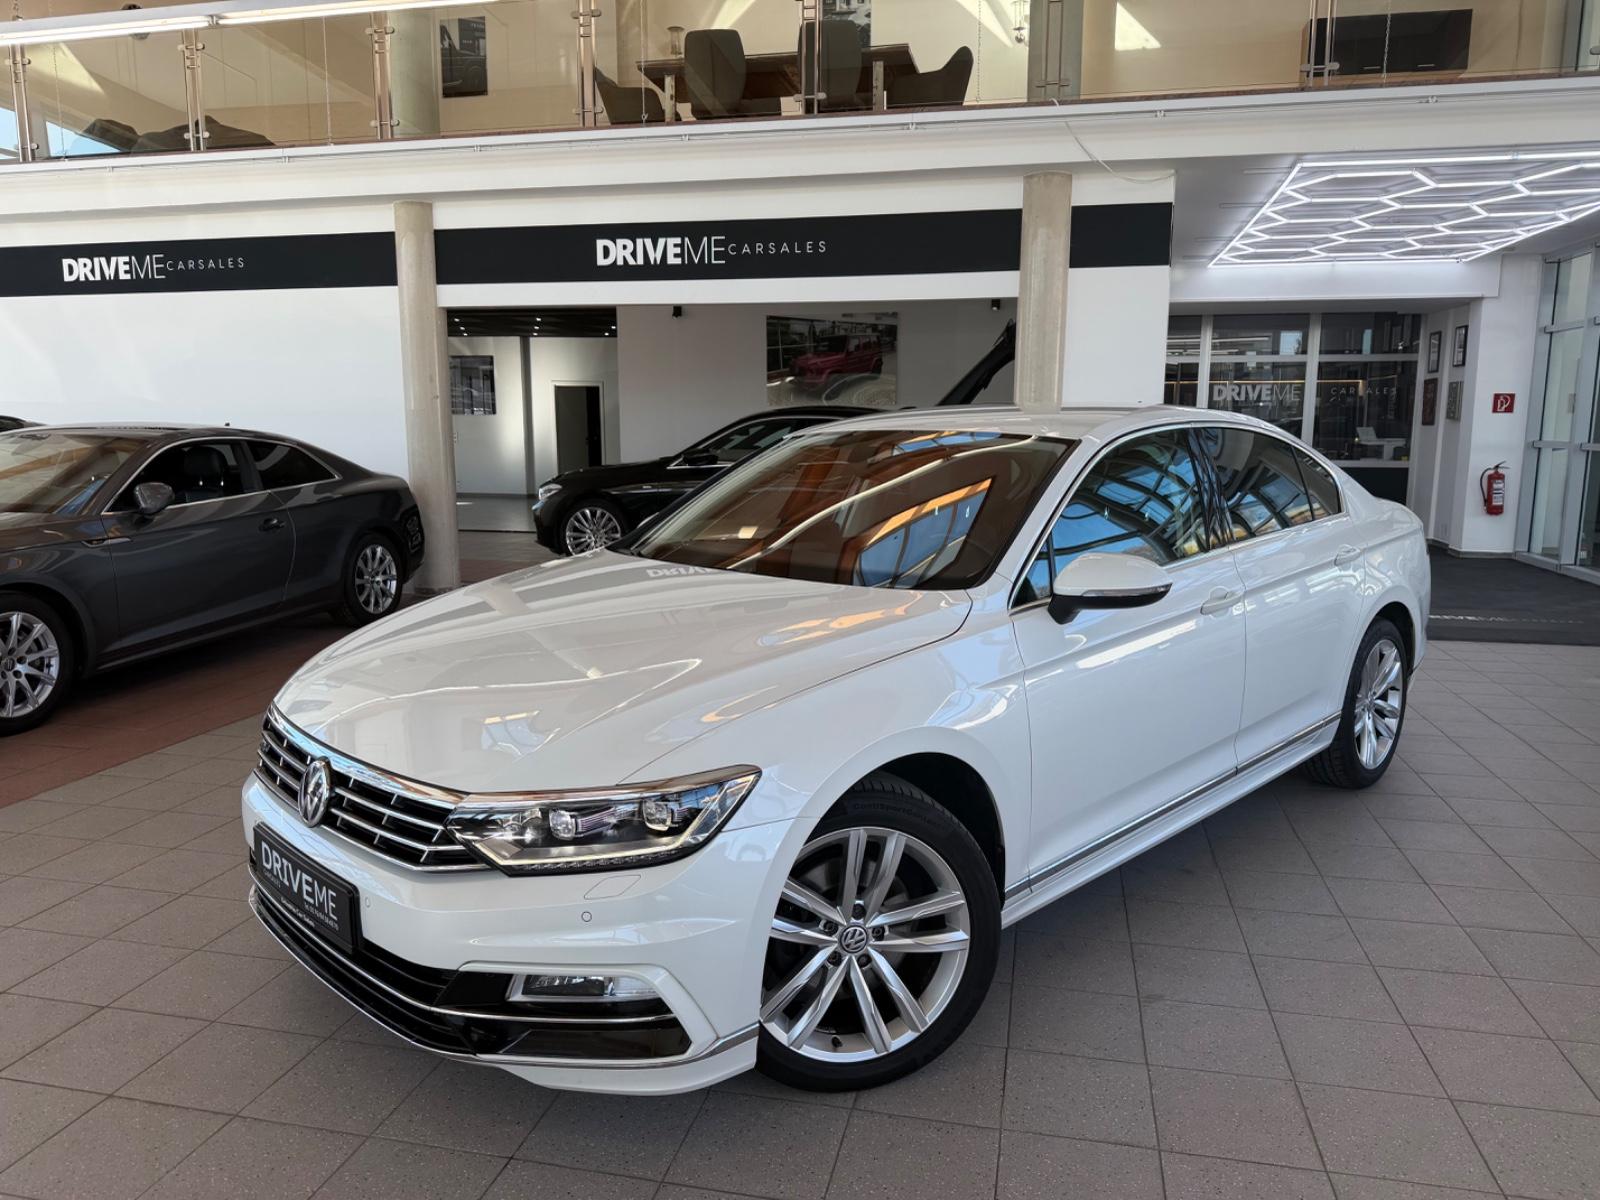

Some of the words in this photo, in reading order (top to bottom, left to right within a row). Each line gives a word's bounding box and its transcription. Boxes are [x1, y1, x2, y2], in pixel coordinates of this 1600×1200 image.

[596, 235, 726, 267] DRIVEME
[728, 240, 827, 256] CARSALES
[61, 253, 166, 283] DRIVEME
[167, 257, 246, 271] CARSALES
[1330, 386, 1397, 396] CARALES
